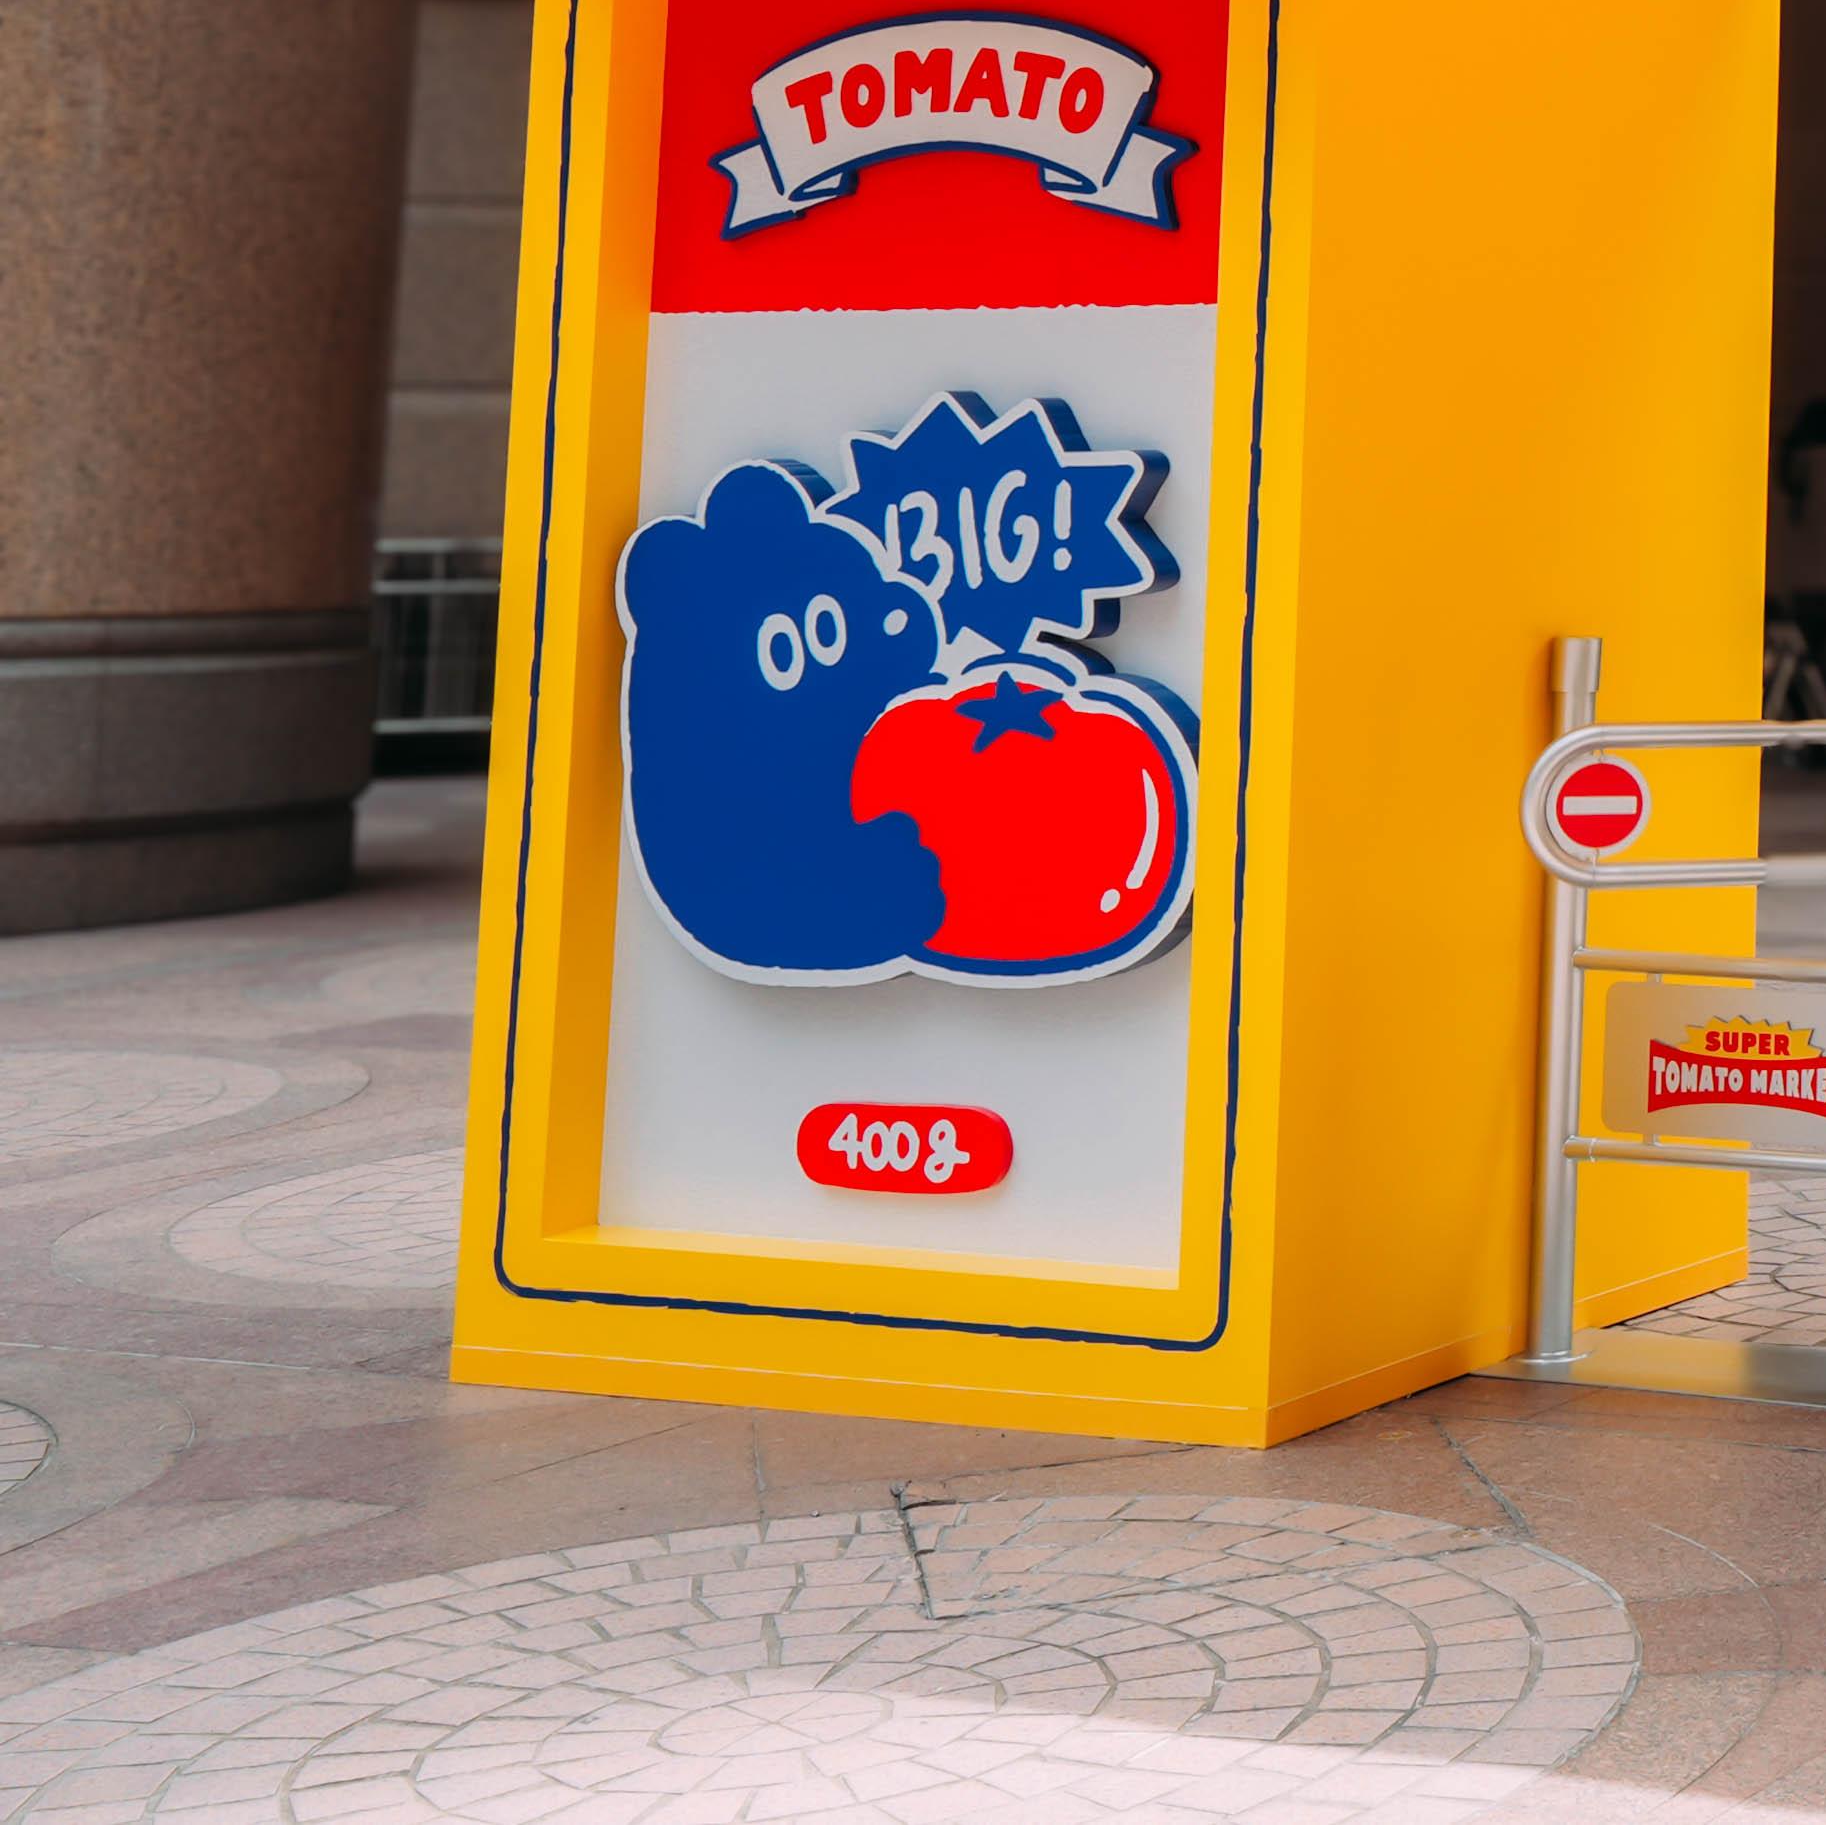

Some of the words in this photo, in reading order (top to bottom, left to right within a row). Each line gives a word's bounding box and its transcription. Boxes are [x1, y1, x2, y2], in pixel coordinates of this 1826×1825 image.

[784, 47, 1106, 145] TOMATO
[884, 469, 1073, 603] BIG!
[1652, 1056, 1744, 1096] TOMATO
[1704, 1030, 1790, 1056] SUPER
